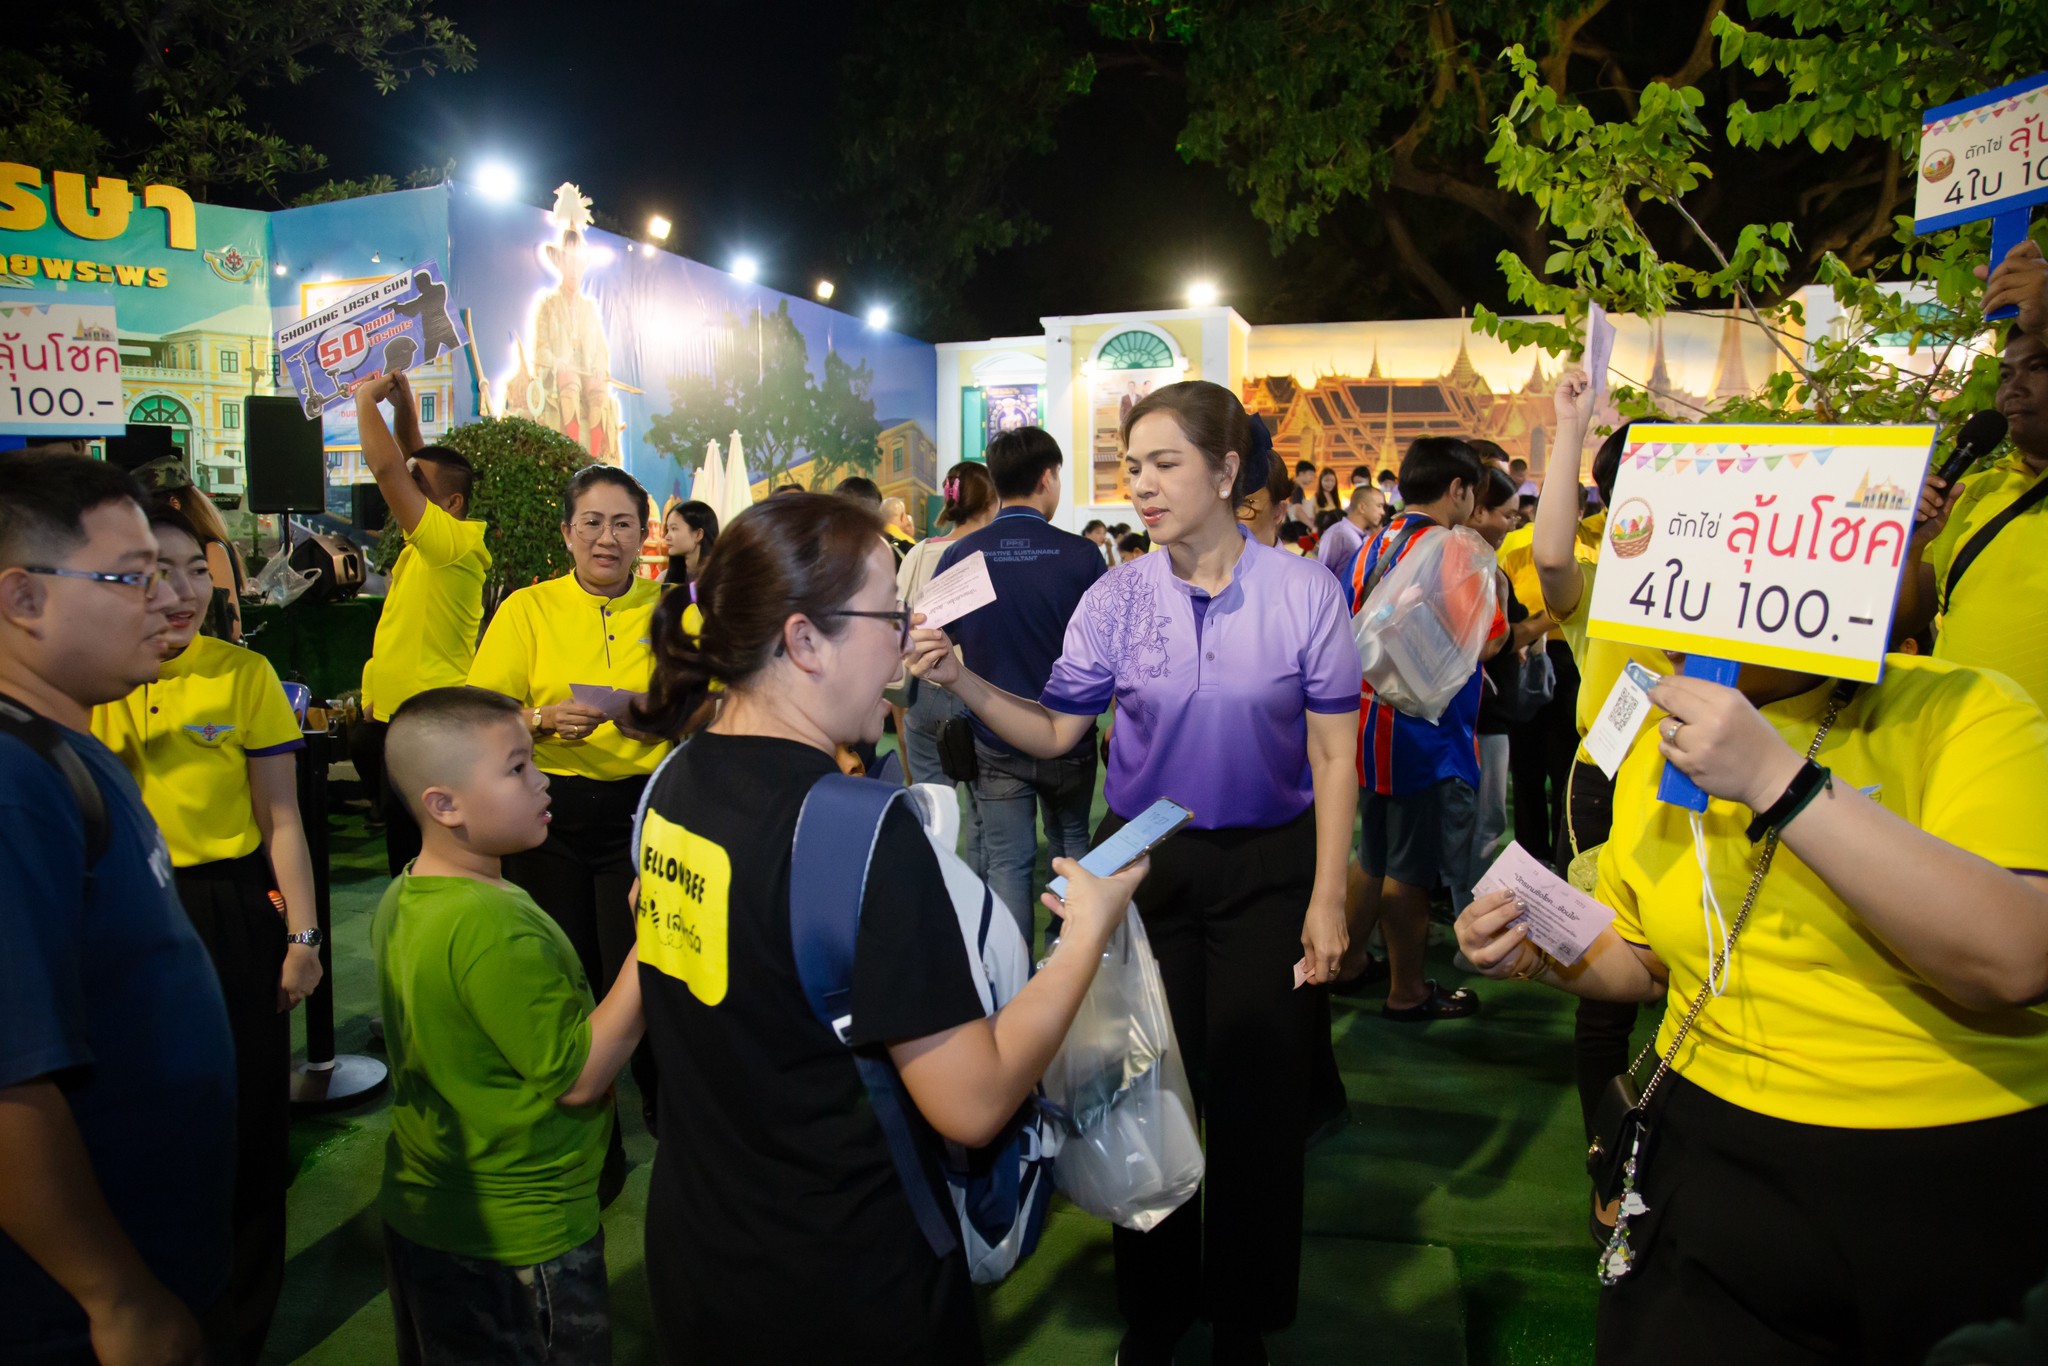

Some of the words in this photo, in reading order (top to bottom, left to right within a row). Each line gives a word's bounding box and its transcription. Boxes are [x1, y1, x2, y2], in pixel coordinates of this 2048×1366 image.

[281, 310, 339, 344] SHOOTING
[343, 290, 380, 315] LASER
[383, 276, 408, 295] GUN
[365, 311, 395, 333] BAHT
[318, 326, 366, 369] 50
[10, 387, 114, 417] 100.-
[1668, 511, 1722, 539] ตักไข่
[1727, 494, 1905, 574] ลุ้นโชค
[1629, 558, 1711, 621] 4ใบ
[1737, 582, 1873, 642] 100.-
